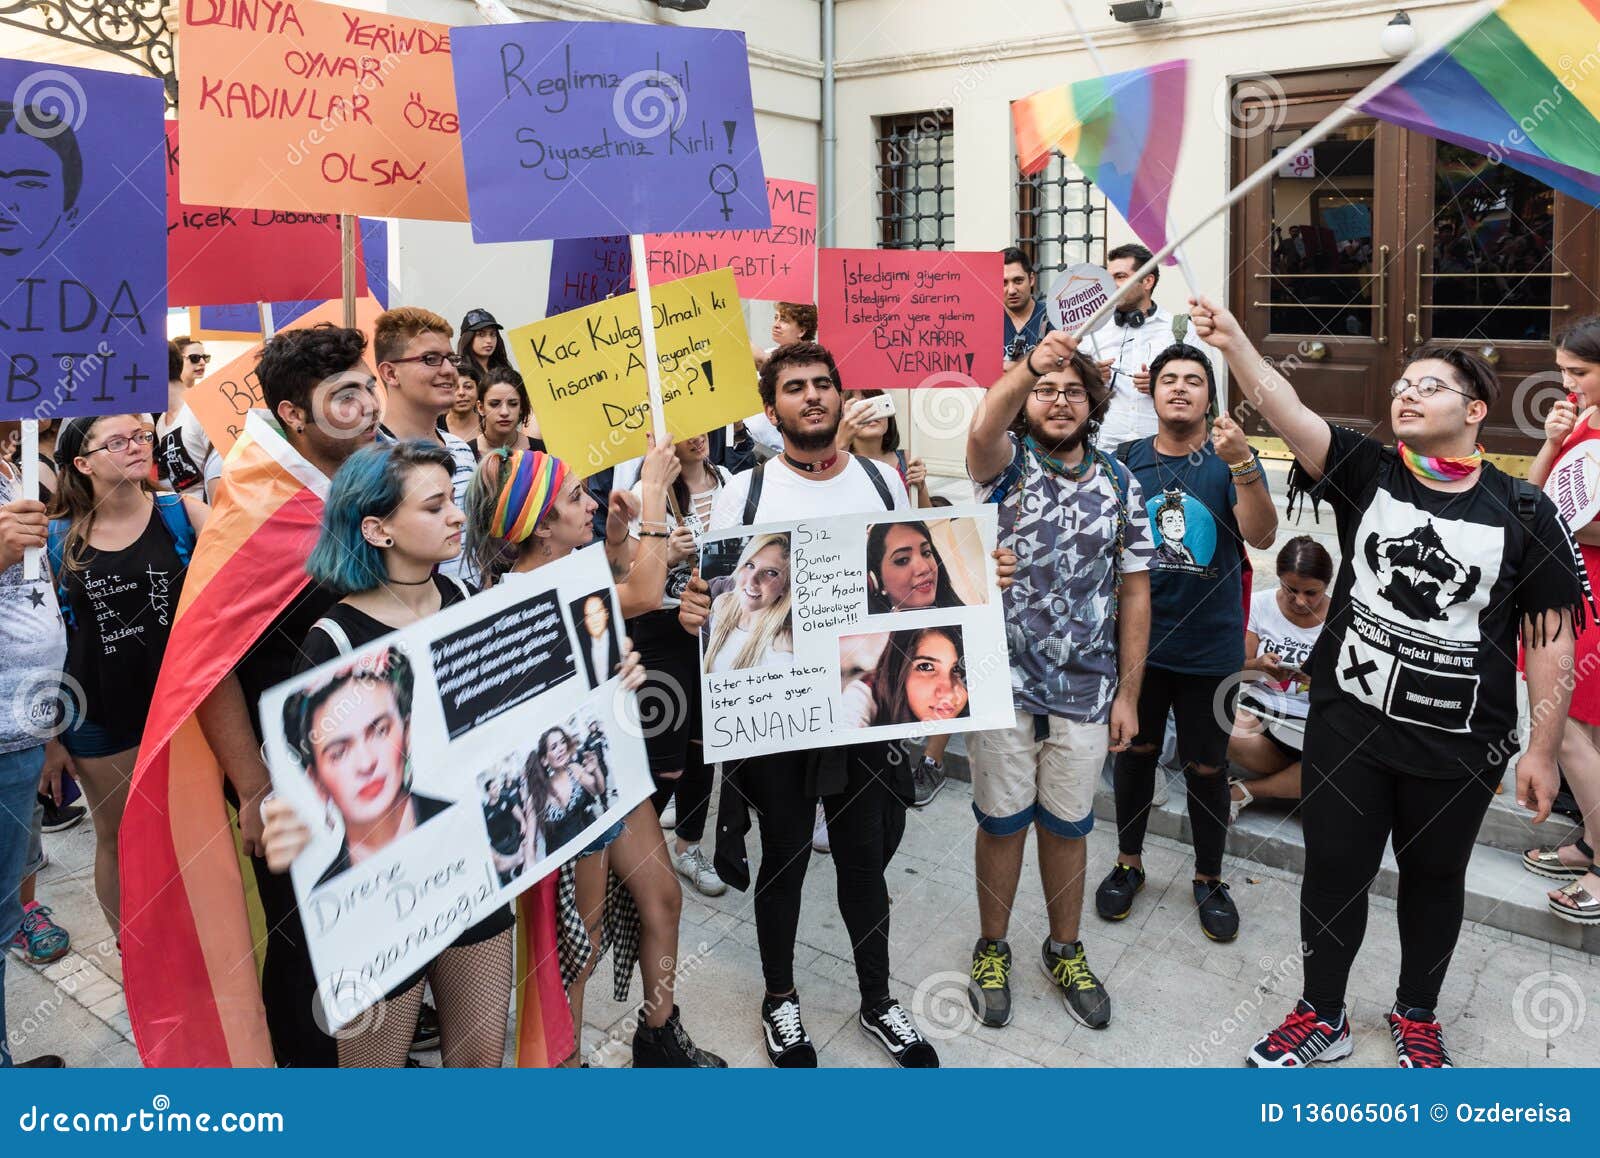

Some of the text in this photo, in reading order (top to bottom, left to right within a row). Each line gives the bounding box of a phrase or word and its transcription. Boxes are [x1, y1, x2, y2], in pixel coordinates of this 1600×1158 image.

[284, 51, 384, 87] OYNAR
[500, 43, 621, 113] Reglimiz
[199, 76, 459, 134] KADINLAR ÖZG
[516, 127, 654, 181] Siyasetiniz
[321, 152, 426, 187] OLSA!
[0, 279, 147, 335] IDA
[1060, 293, 1109, 326] karışma
[530, 335, 581, 369] Kaç
[587, 315, 641, 352] Kulağ
[710, 291, 727, 311] ki
[918, 329, 968, 349] KARAR
[797, 523, 832, 545] Siz
[85, 574, 121, 590] don't
[796, 568, 862, 585] Okuyorken
[87, 581, 138, 600] believe
[796, 583, 865, 605] Bir Kadın
[93, 600, 106, 612] in
[96, 608, 121, 622] art.
[101, 624, 144, 645] believe
[103, 644, 117, 655] in
